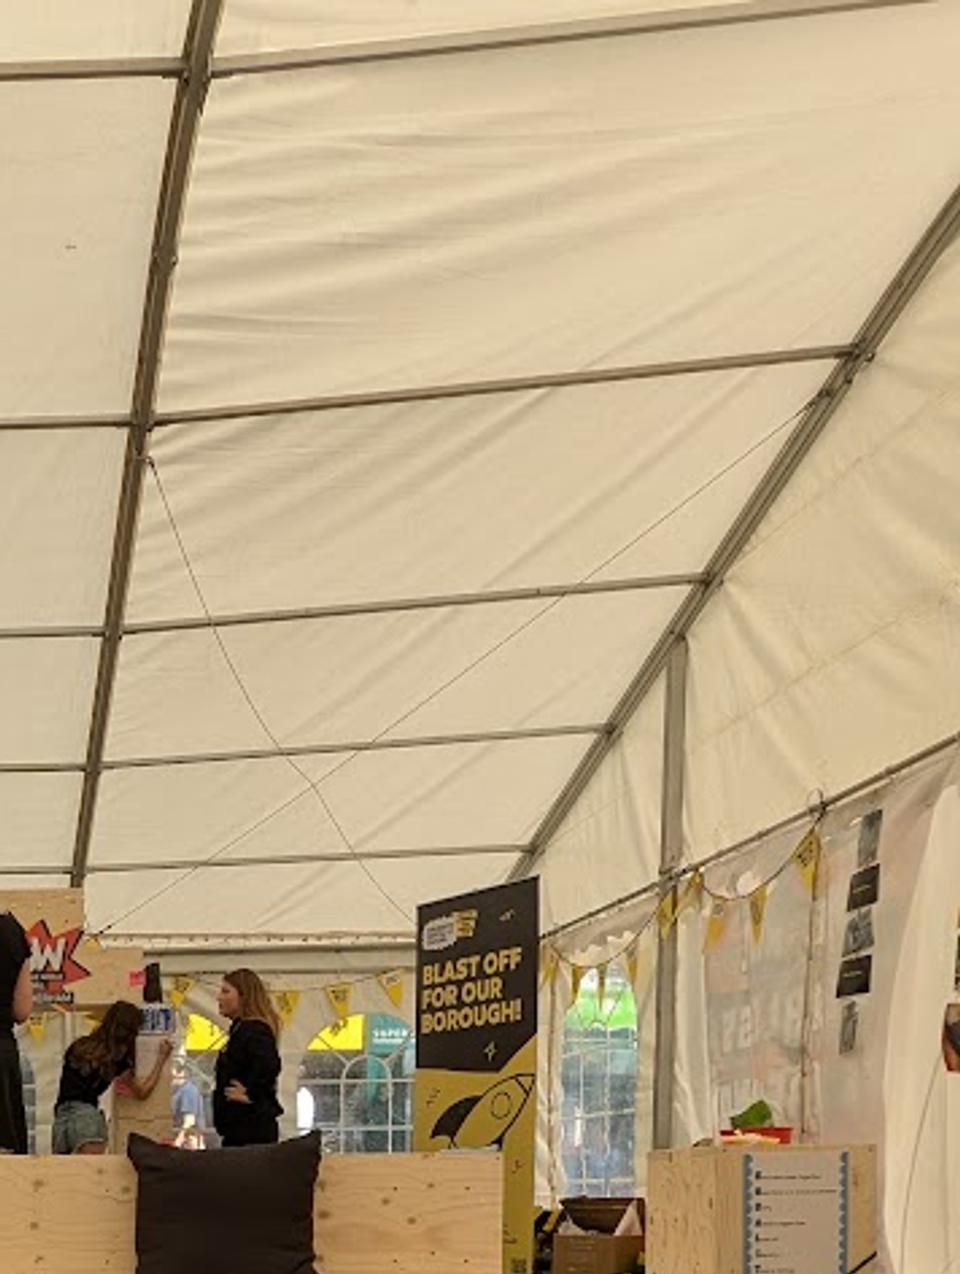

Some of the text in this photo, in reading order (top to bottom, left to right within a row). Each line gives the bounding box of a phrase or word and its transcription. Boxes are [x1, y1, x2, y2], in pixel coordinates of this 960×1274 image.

[422, 954, 480, 985] BLAST
[483, 947, 523, 973] OFF
[422, 977, 503, 1011] FOR OUR
[420, 998, 522, 1034] BOROUGH!
